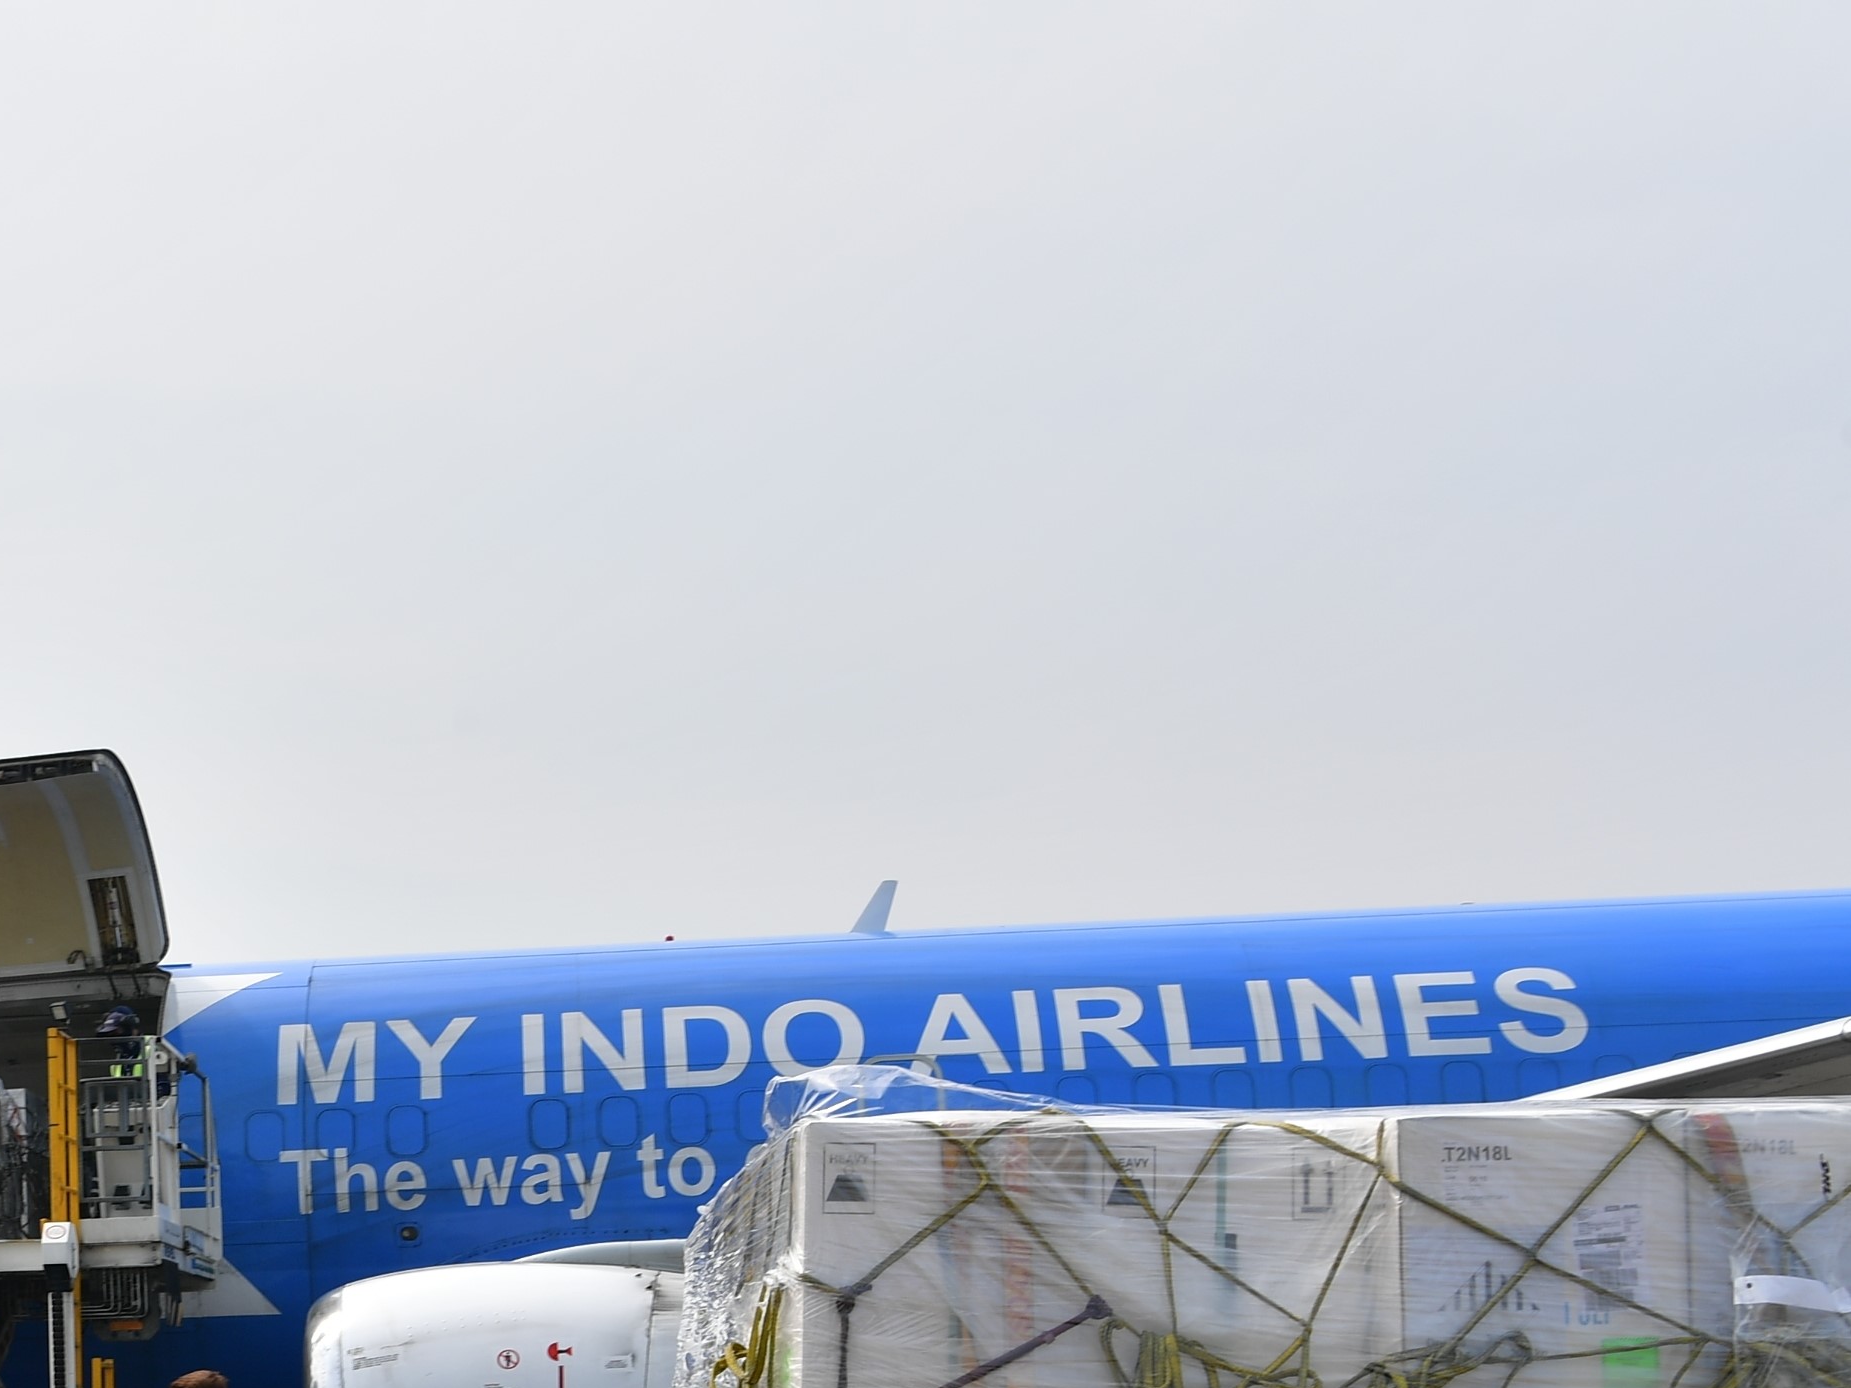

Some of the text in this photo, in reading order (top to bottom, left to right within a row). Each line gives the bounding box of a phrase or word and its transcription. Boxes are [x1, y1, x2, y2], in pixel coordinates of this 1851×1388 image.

[277, 967, 1590, 1105] MY INDO AIRLINES
[278, 1133, 717, 1221] The way to
[1117, 1157, 1150, 1170] EAVY
